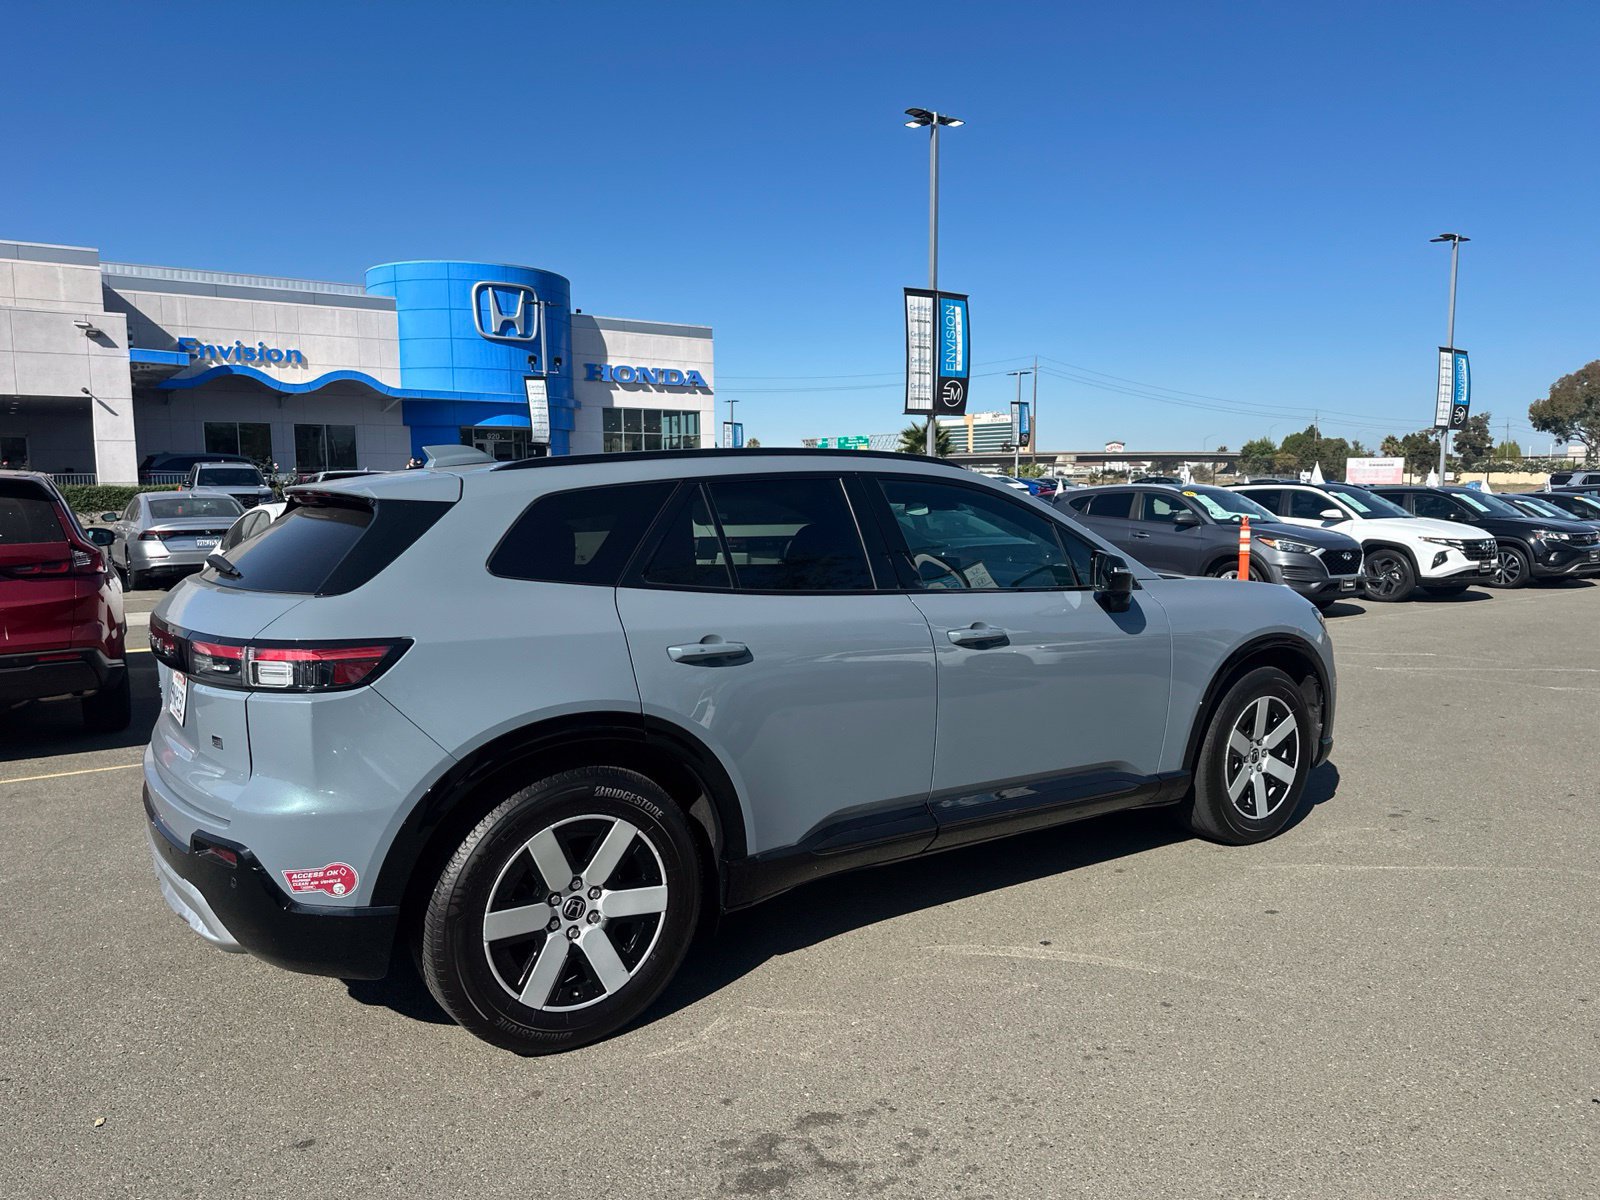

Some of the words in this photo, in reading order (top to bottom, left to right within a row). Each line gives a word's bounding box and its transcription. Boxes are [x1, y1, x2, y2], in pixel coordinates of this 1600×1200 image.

[178, 337, 302, 363] Envision
[946, 304, 956, 371] ENVISION
[583, 363, 709, 387] HONDA
[486, 432, 501, 440] 920
[594, 785, 665, 819] BRIDGESTONE
